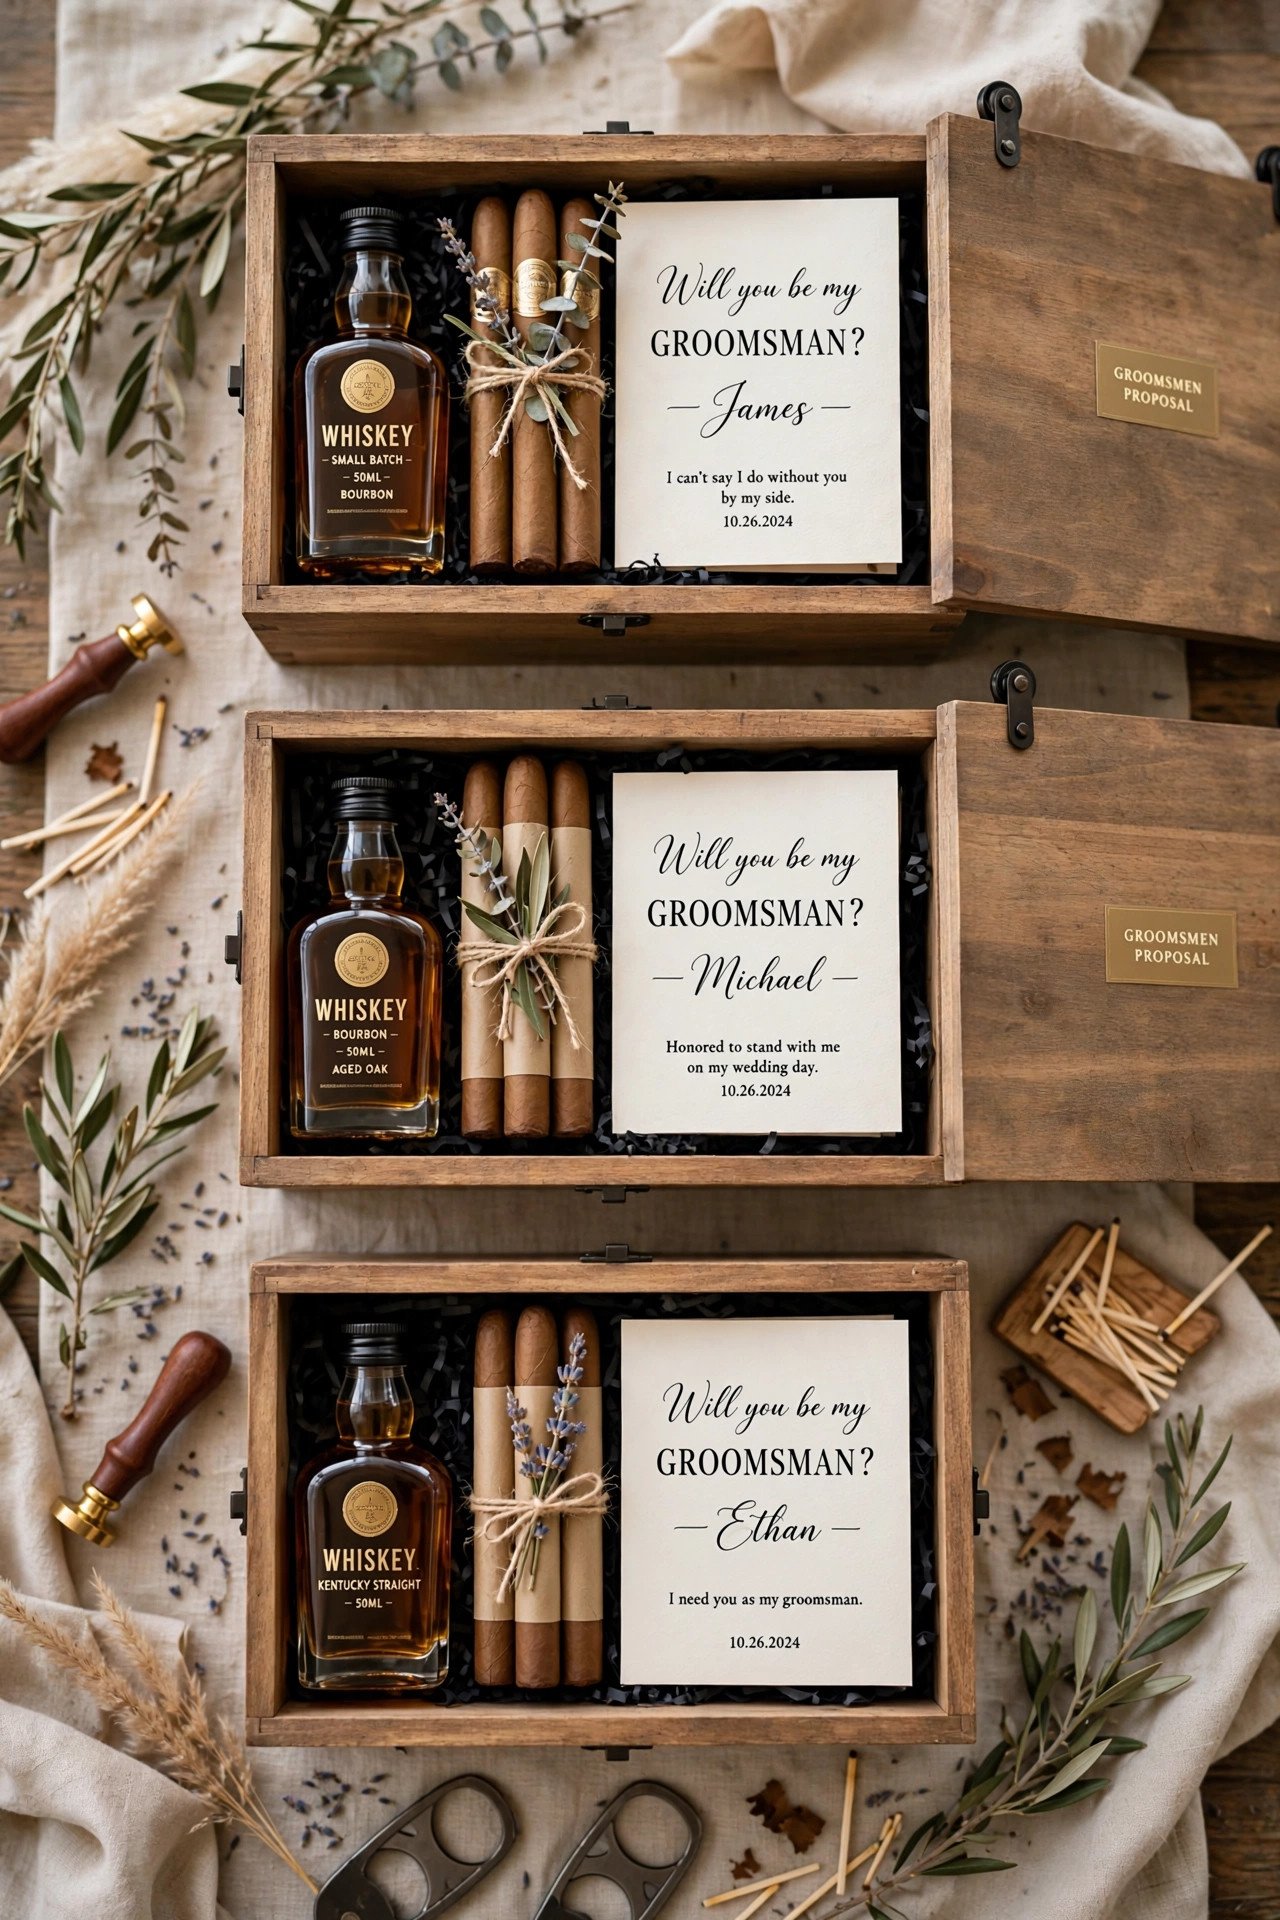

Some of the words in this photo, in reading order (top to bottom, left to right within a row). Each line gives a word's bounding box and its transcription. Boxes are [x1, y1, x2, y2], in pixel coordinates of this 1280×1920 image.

[657, 262, 736, 306] Will
[728, 284, 781, 317] you
[788, 267, 817, 299] be
[823, 283, 862, 316] my
[651, 327, 865, 357] GROOMSMAN?
[1114, 366, 1202, 395] GROOMSMEN
[1124, 387, 1194, 413] PROPOSAL
[700, 380, 813, 438] James
[322, 424, 414, 447] WHISKEY
[331, 454, 366, 465] SMALL
[369, 454, 403, 465] BATCH
[353, 472, 382, 483] 50ML
[667, 471, 673, 484] I
[677, 471, 708, 484] can't
[712, 473, 733, 487] say
[737, 471, 743, 484] I
[747, 470, 764, 484] do
[768, 470, 819, 484] without
[823, 472, 847, 487] you
[340, 489, 394, 500] BOURBON
[721, 490, 737, 507] by
[741, 493, 761, 507] my
[765, 490, 795, 504] side.
[723, 515, 793, 528] 10.26.2024
[653, 831, 734, 875] Will
[725, 853, 779, 887] you
[786, 837, 815, 869] be
[821, 853, 860, 887] my
[648, 897, 864, 927] GROOMSMAN?
[1124, 928, 1219, 946] GROOMSMEN
[1135, 948, 1210, 966] PROPOSAL
[690, 953, 828, 1000] Michael
[314, 998, 408, 1021] WHISKEY
[333, 1029, 388, 1040] BOURBON
[346, 1047, 376, 1057] 50ML
[666, 1040, 724, 1054] Honored
[729, 1042, 742, 1054] to
[747, 1040, 782, 1054] stand
[787, 1040, 816, 1054] with
[821, 1043, 841, 1054] me
[332, 1064, 362, 1075] AGED
[365, 1064, 389, 1075] OAK
[687, 1063, 703, 1074] on
[708, 1063, 728, 1077] my
[732, 1060, 788, 1077] wedding
[792, 1060, 819, 1077] day.
[721, 1084, 791, 1097] 10.26.2024
[662, 1379, 744, 1424] Will
[735, 1402, 790, 1435] you
[796, 1385, 825, 1418] be
[831, 1402, 871, 1435] my
[656, 1446, 874, 1476] GROOMSMAN?
[716, 1499, 822, 1551] Ethan
[322, 1548, 416, 1572] WHISKEY
[318, 1579, 370, 1591] KENTUCKY
[373, 1579, 422, 1591] STRAIGHT
[355, 1598, 383, 1609] 50ML
[669, 1592, 674, 1605] I
[679, 1592, 709, 1605] need
[713, 1595, 738, 1609] you
[742, 1595, 755, 1605] as
[759, 1595, 779, 1609] my
[782, 1595, 863, 1609] groomsman.
[730, 1636, 801, 1650] 10.26.2024
